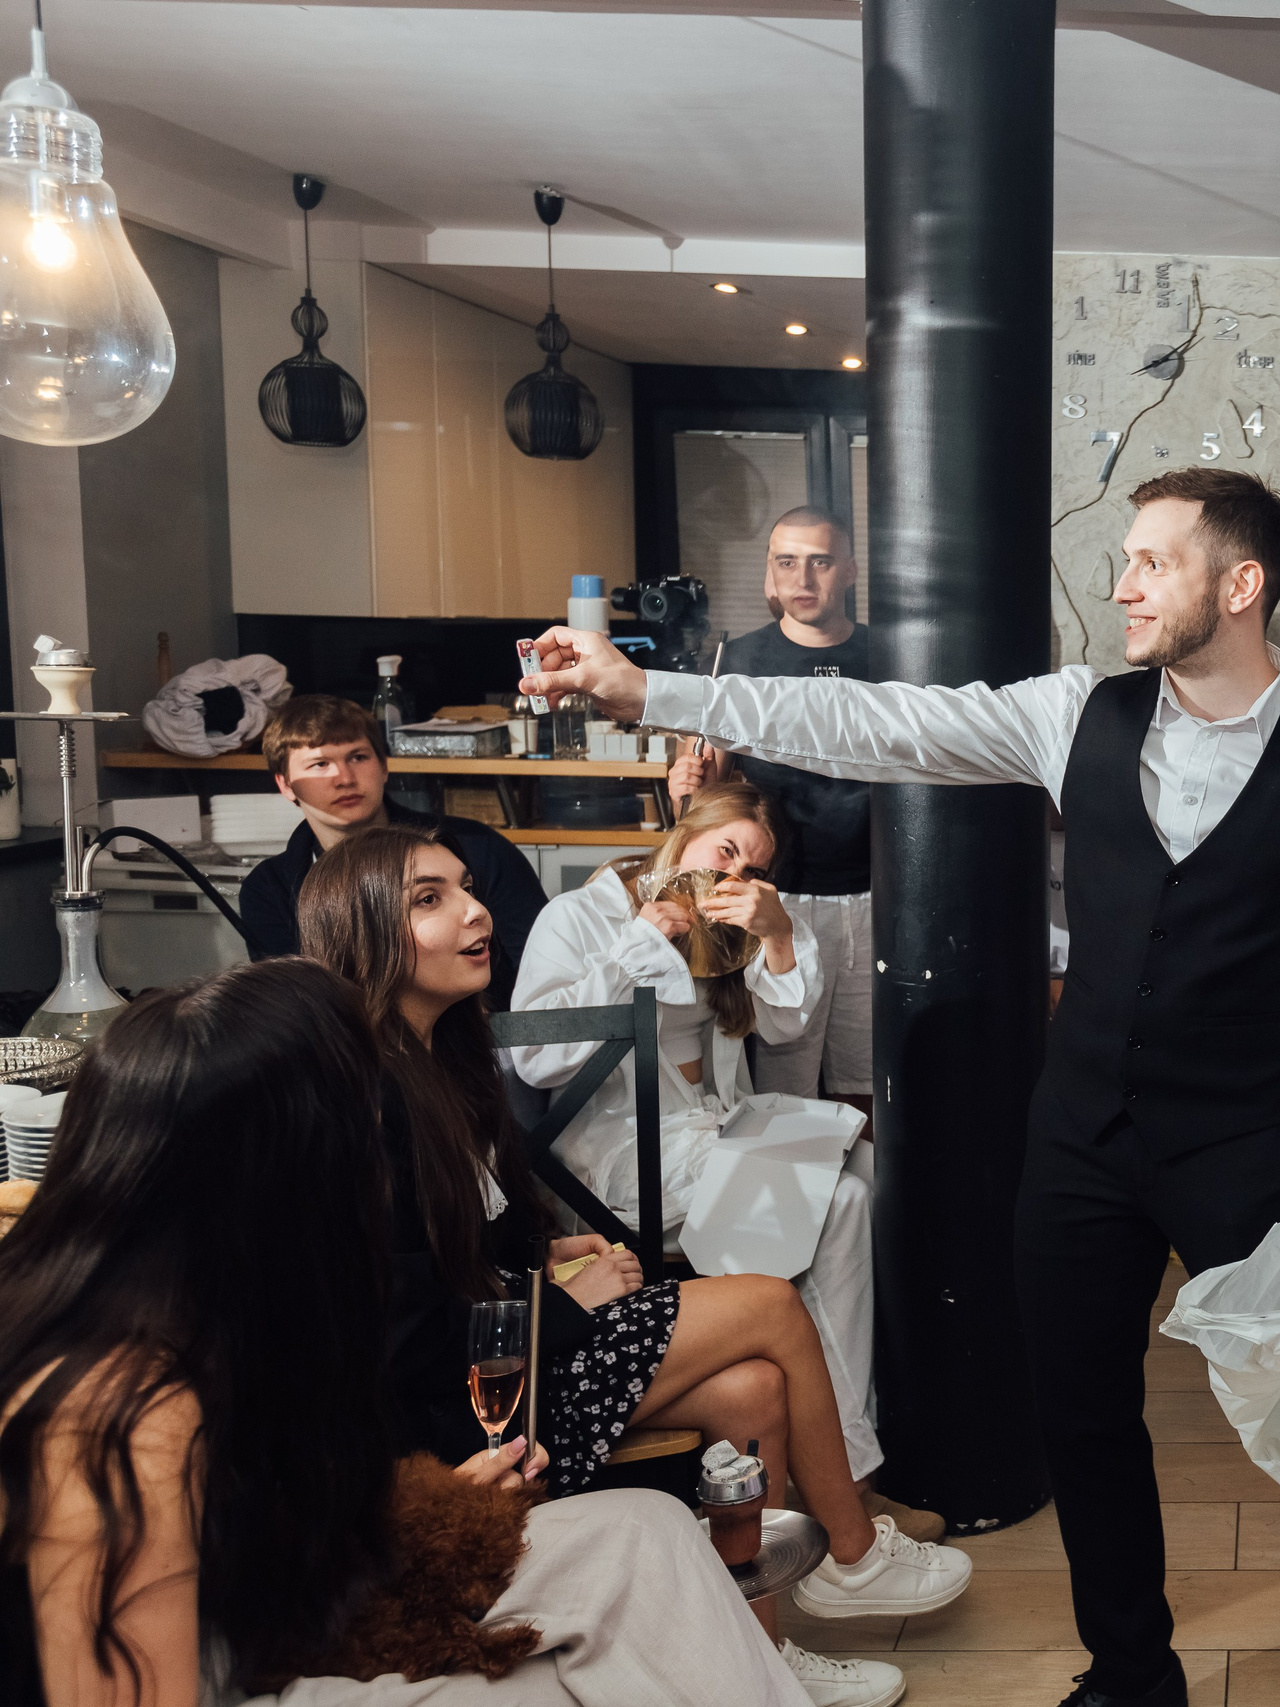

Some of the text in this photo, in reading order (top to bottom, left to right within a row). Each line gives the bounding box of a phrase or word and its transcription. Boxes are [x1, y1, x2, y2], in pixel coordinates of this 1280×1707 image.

[1115, 270, 1141, 294] 11
[1213, 316, 1239, 341] 2
[1062, 394, 1087, 418] 8
[1242, 404, 1266, 437] 4
[1090, 431, 1123, 482] 7
[1200, 432, 1221, 461] 5
